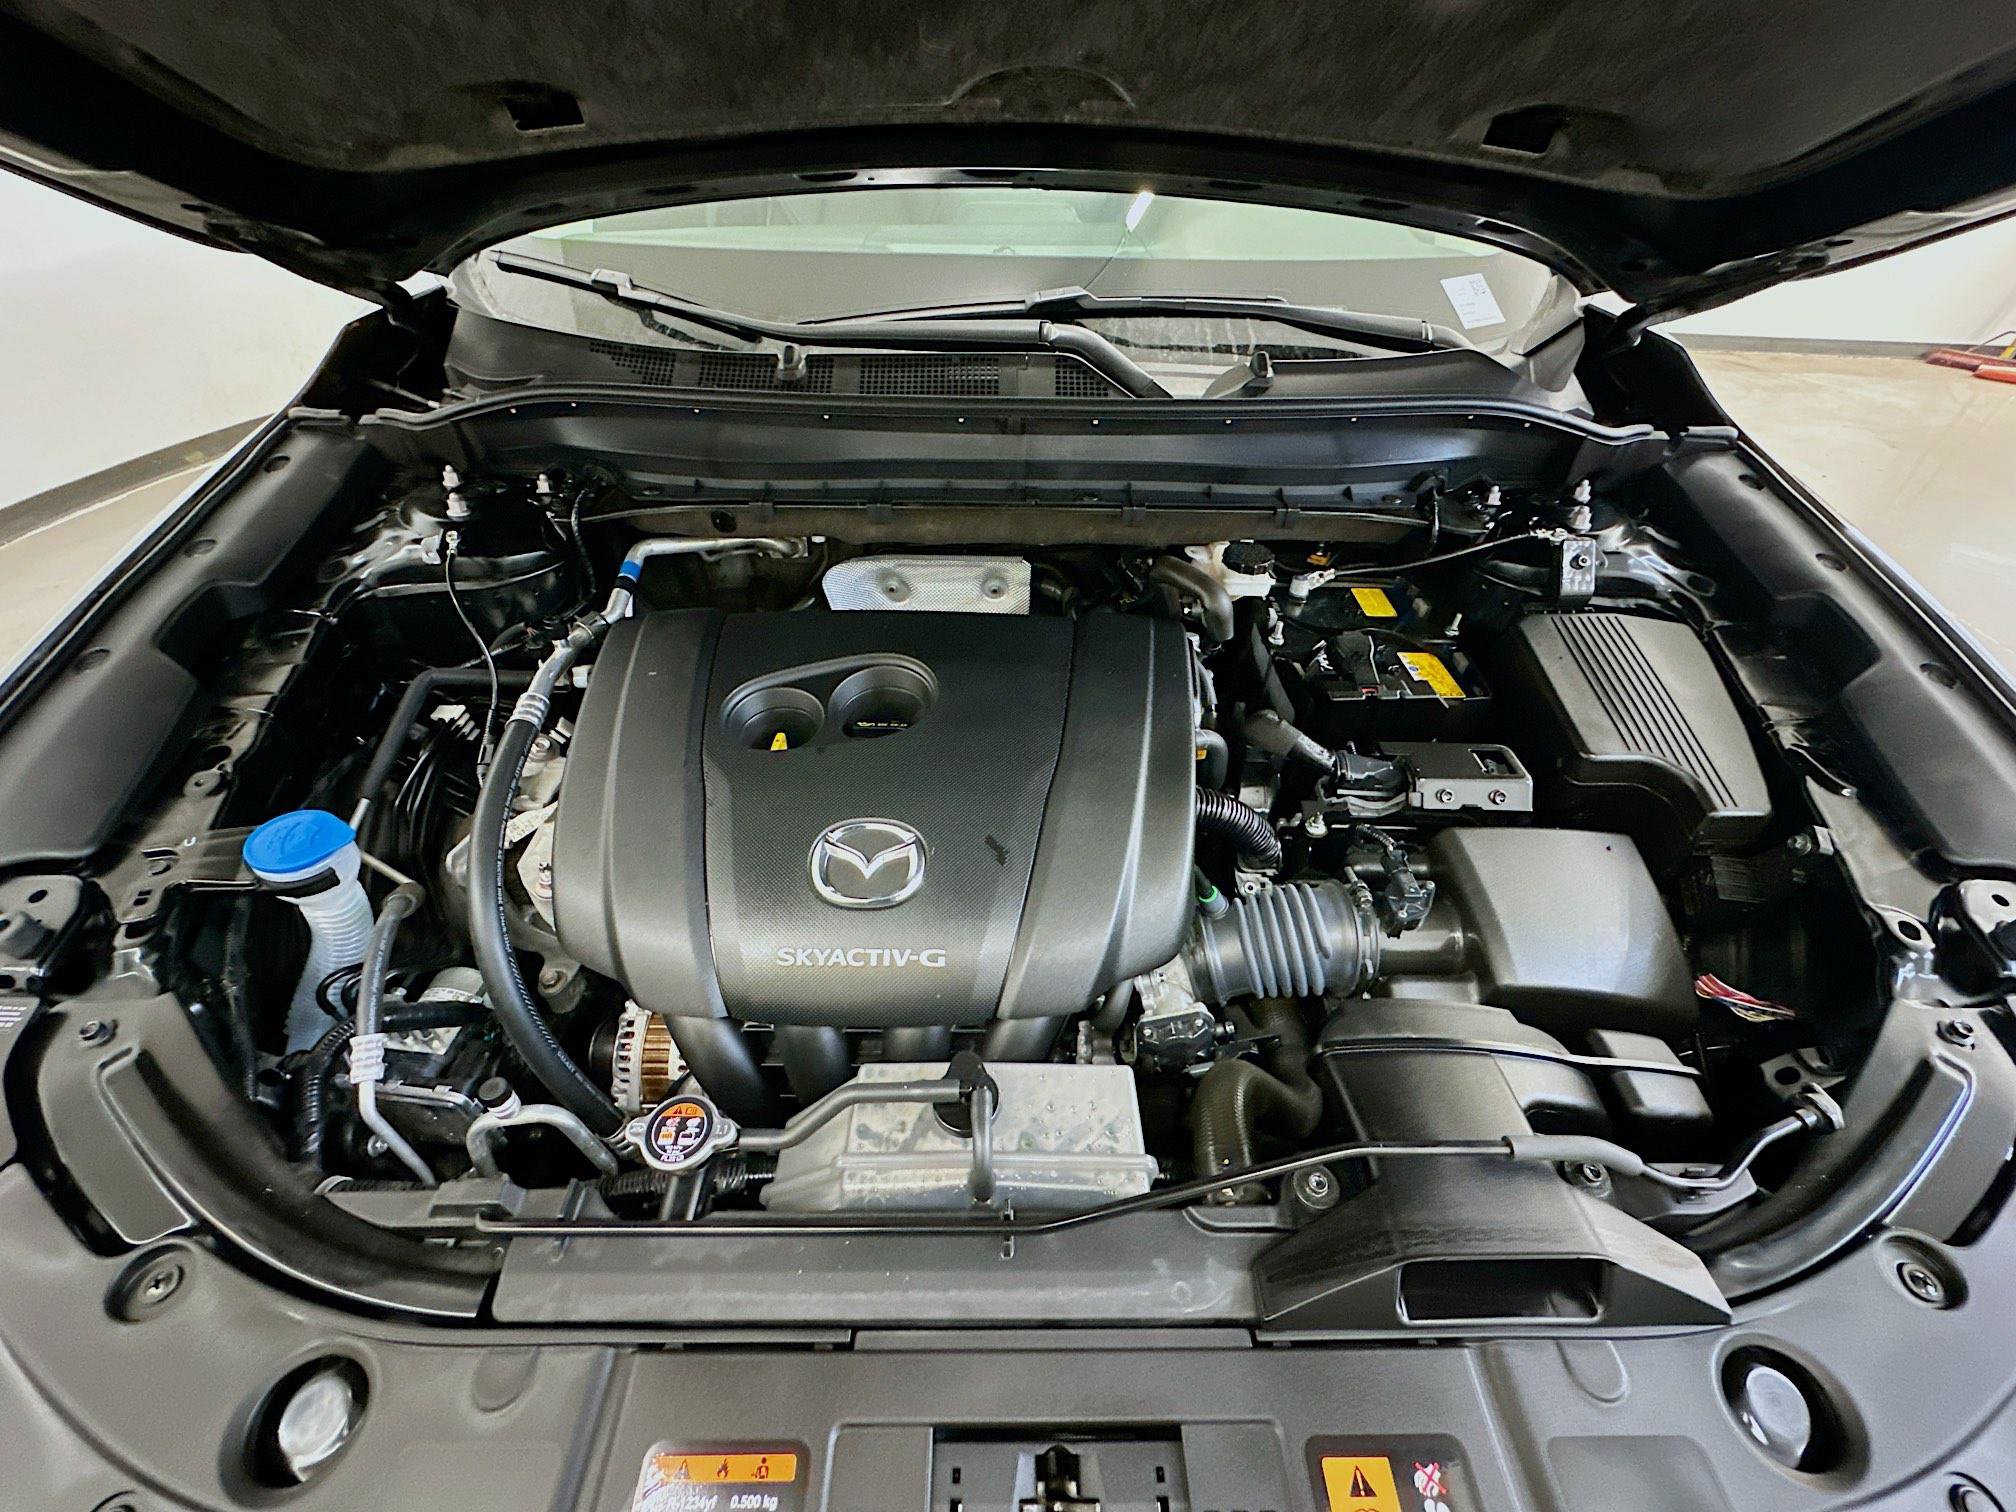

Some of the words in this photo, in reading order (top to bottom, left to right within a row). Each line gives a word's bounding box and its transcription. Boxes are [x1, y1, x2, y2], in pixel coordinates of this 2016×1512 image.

[776, 948, 946, 967] SKYACTIV-G
[730, 1494, 762, 1510] 0.500
[762, 1494, 779, 1511] kg
